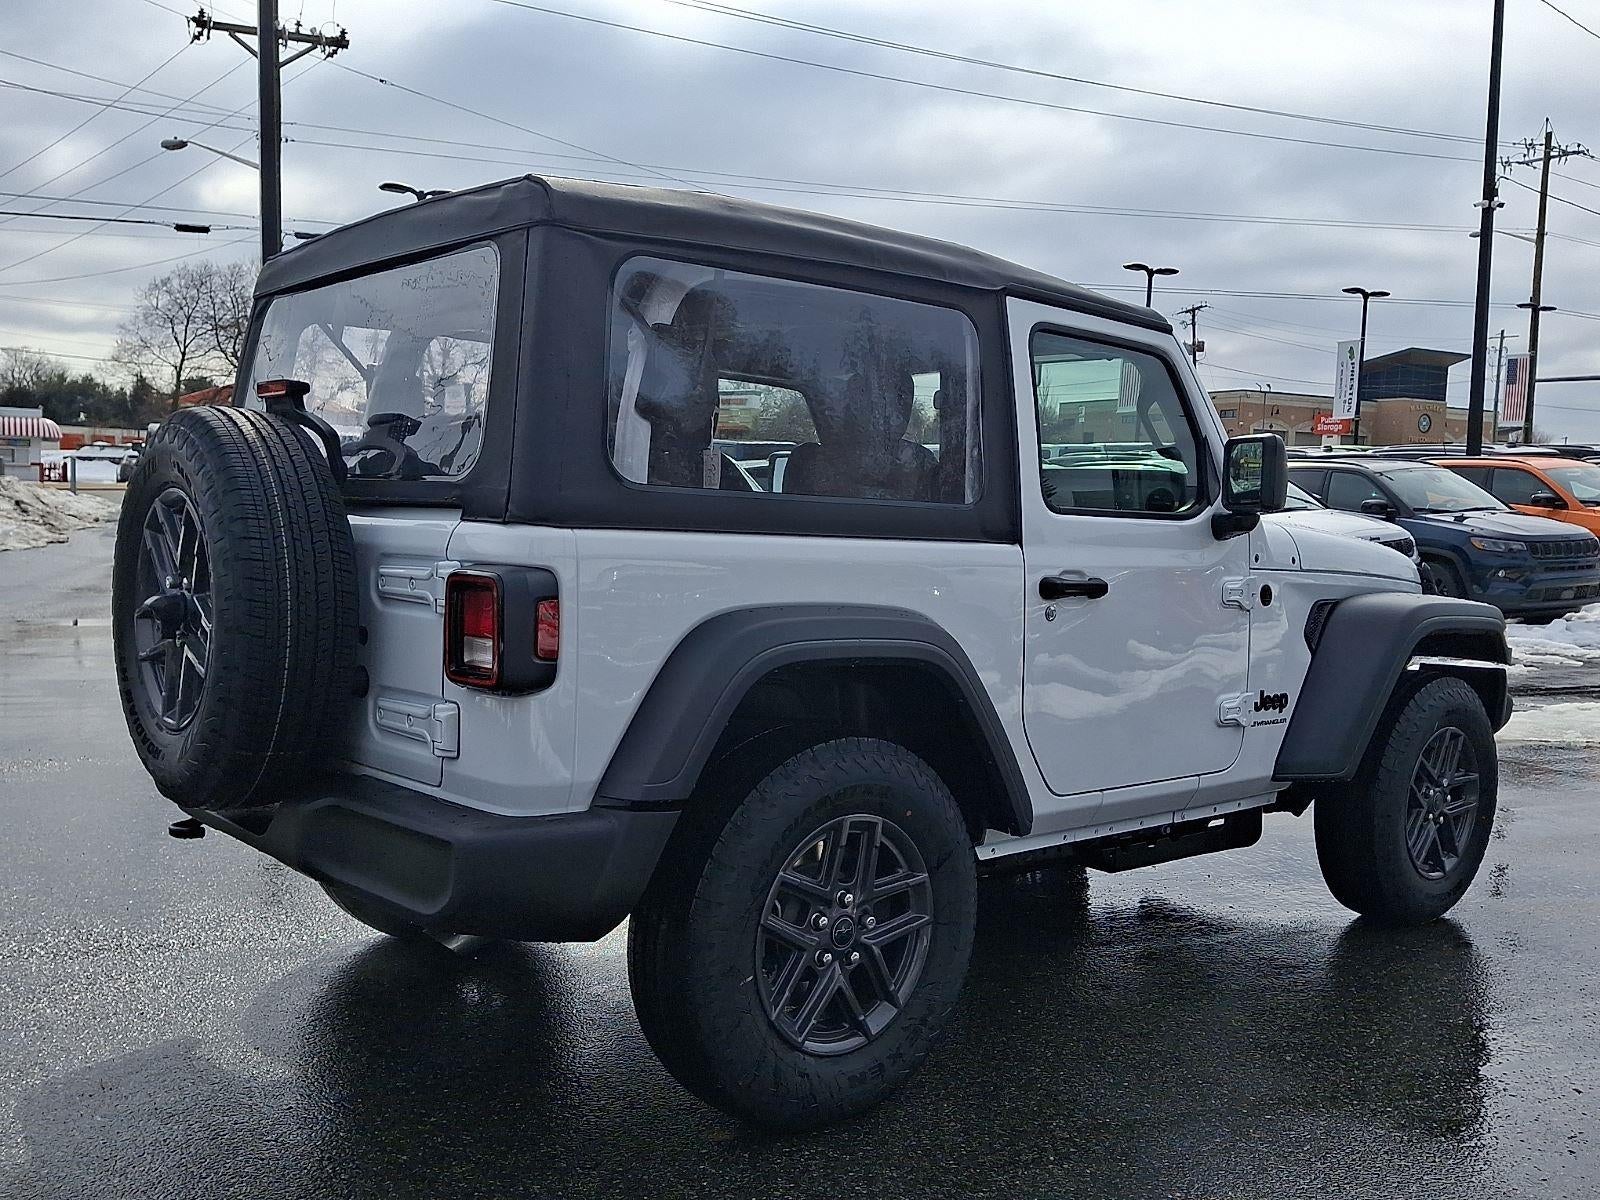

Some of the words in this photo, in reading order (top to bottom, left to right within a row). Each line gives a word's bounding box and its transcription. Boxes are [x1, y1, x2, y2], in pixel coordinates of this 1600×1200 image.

[1346, 361, 1356, 414] PRESTON
[1317, 424, 1343, 433] Storage
[1254, 690, 1288, 714] Jeep
[1253, 718, 1286, 727] WRANGLER
